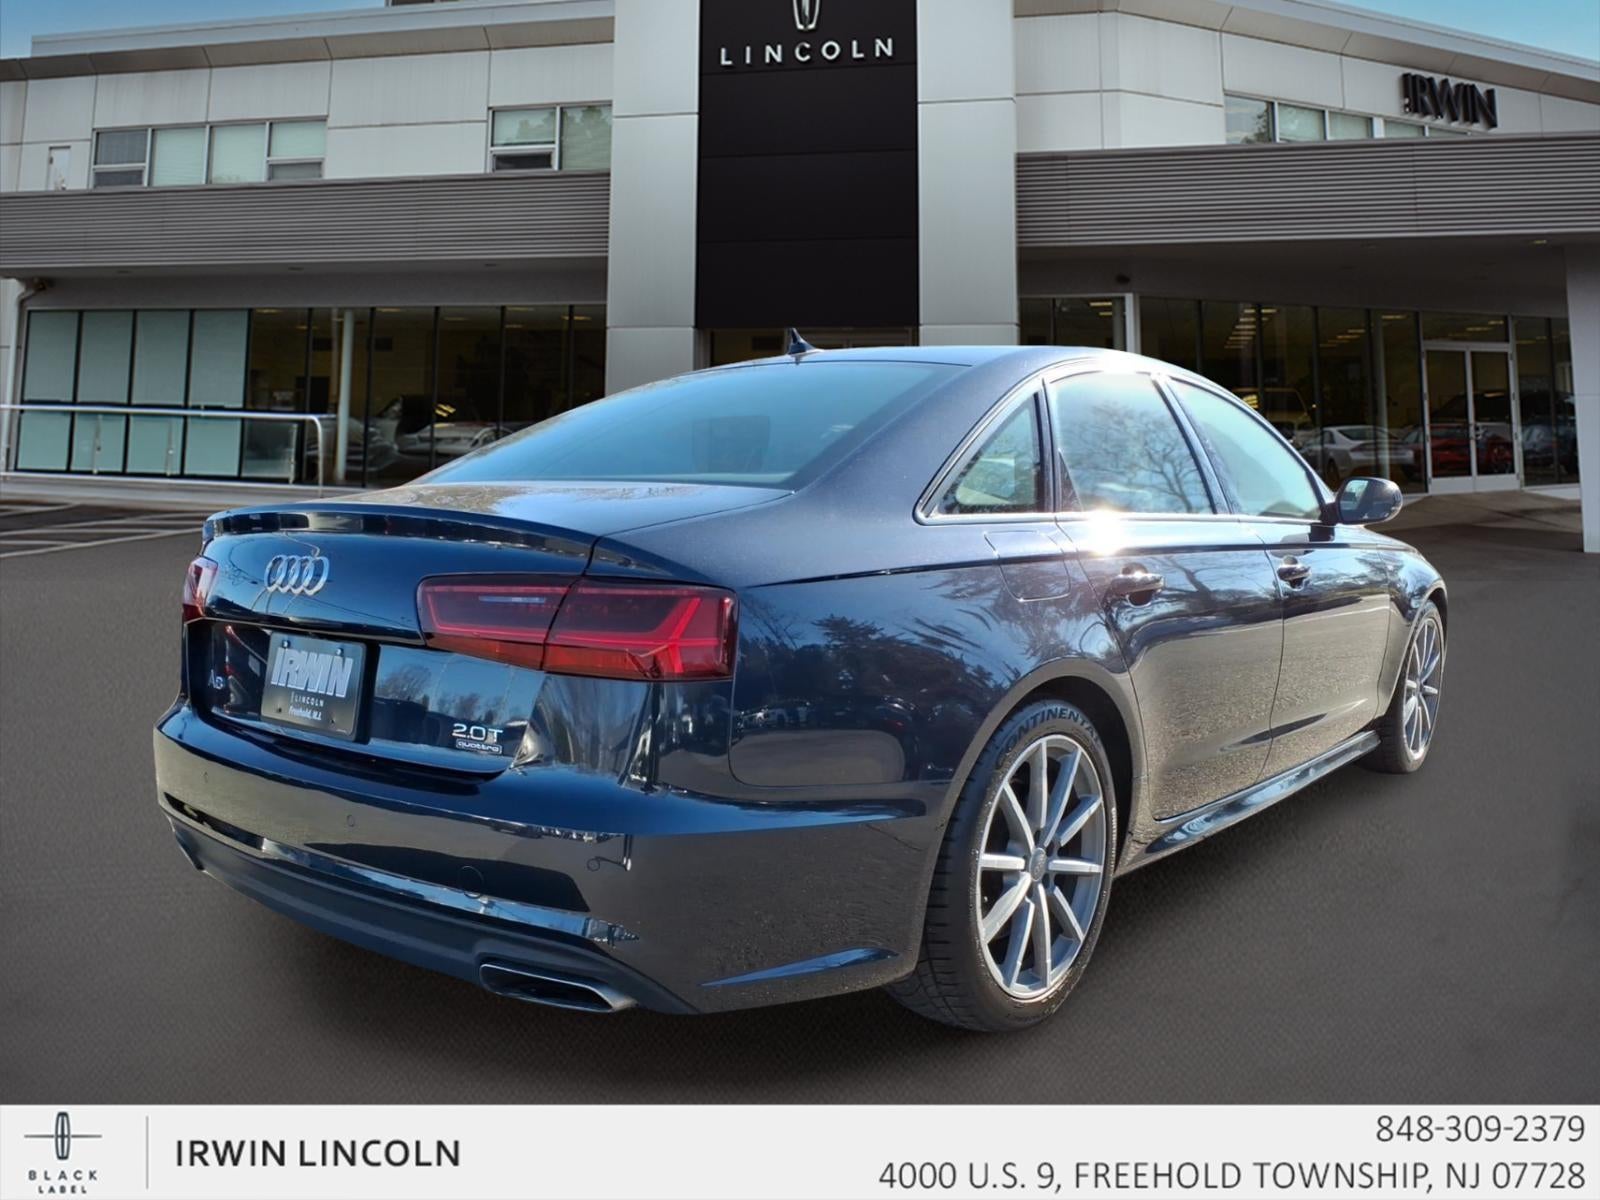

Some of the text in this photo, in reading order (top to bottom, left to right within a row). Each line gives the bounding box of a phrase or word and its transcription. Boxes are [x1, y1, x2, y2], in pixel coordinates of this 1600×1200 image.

[720, 37, 894, 66] LINCOLN
[1400, 72, 1498, 129] IRWIN
[207, 669, 224, 690] A6
[270, 647, 354, 698] IRWIN
[294, 693, 324, 707] LINCOLN
[452, 723, 504, 743] 2.0T
[456, 739, 502, 754] quattro
